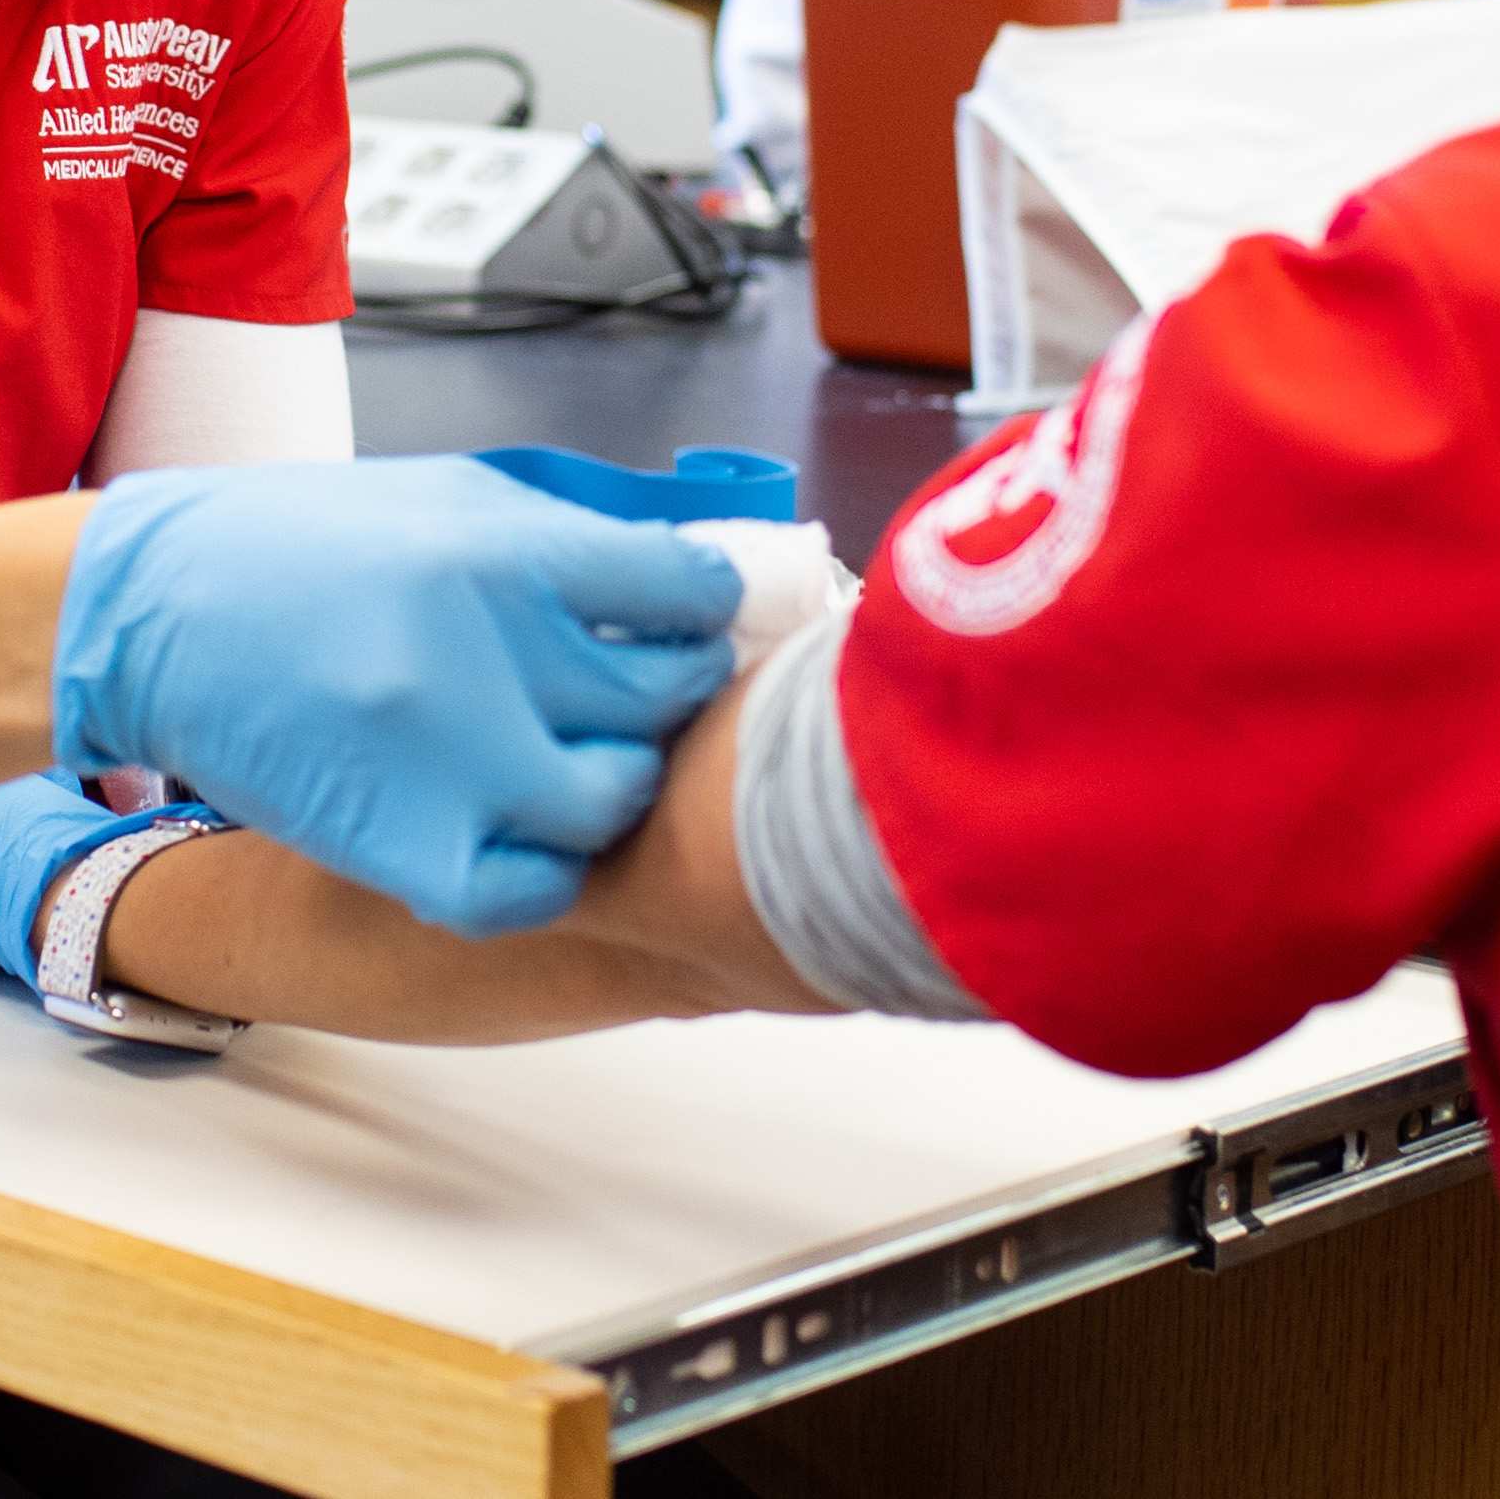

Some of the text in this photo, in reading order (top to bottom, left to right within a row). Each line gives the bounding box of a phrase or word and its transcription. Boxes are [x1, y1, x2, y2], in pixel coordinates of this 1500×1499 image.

[151, 17, 232, 75] Peay
[38, 106, 108, 137] Allied
[42, 158, 112, 181] MEDICAL
